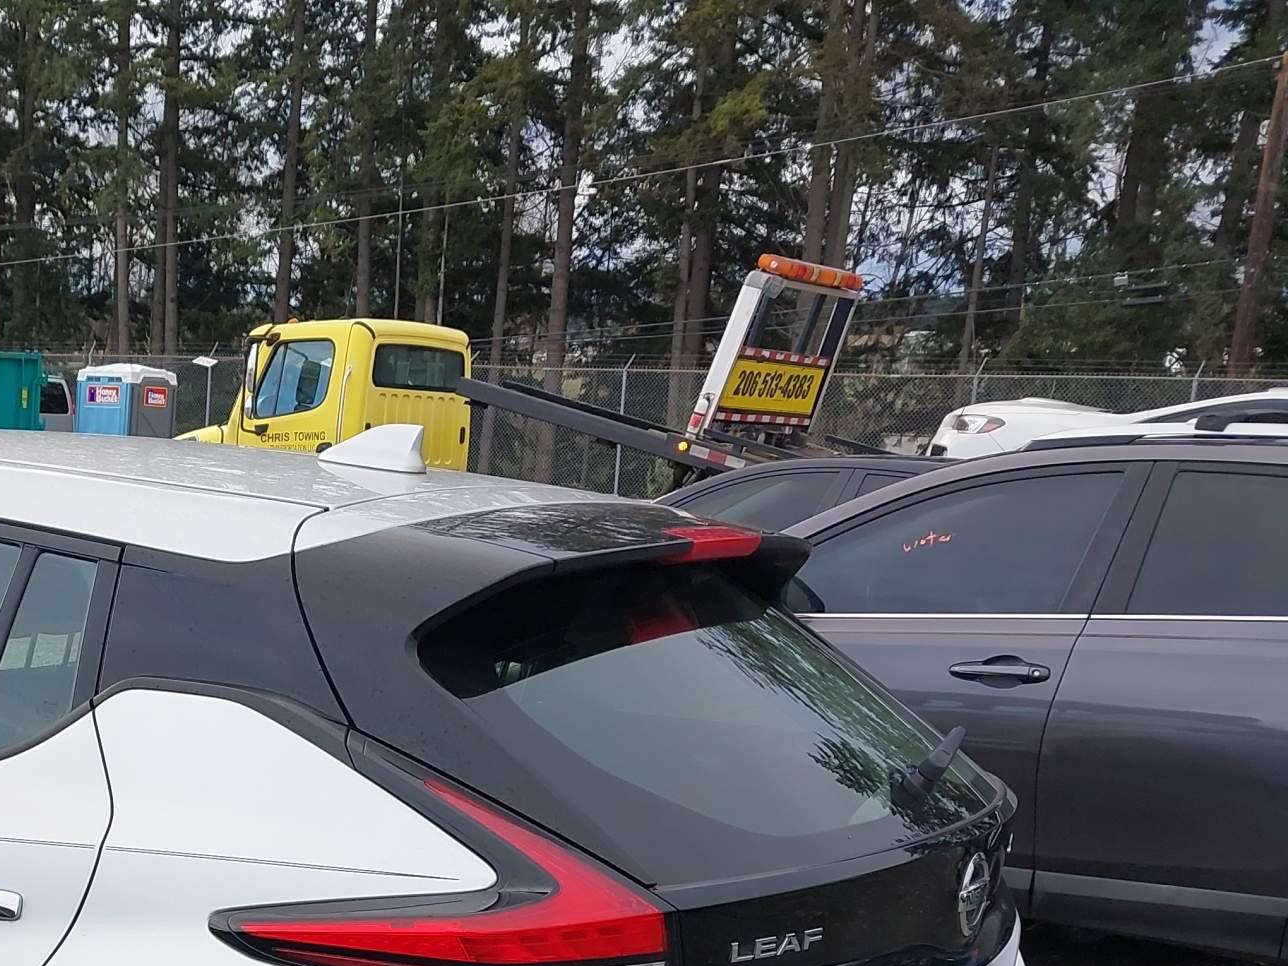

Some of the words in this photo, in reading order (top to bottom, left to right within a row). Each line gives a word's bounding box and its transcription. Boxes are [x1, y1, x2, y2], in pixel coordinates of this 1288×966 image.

[733, 369, 762, 397] 206
[758, 371, 814, 399] 513-4383
[260, 432, 290, 444] CHRIS
[294, 431, 326, 442] TOWING
[729, 927, 824, 964] LEAF
